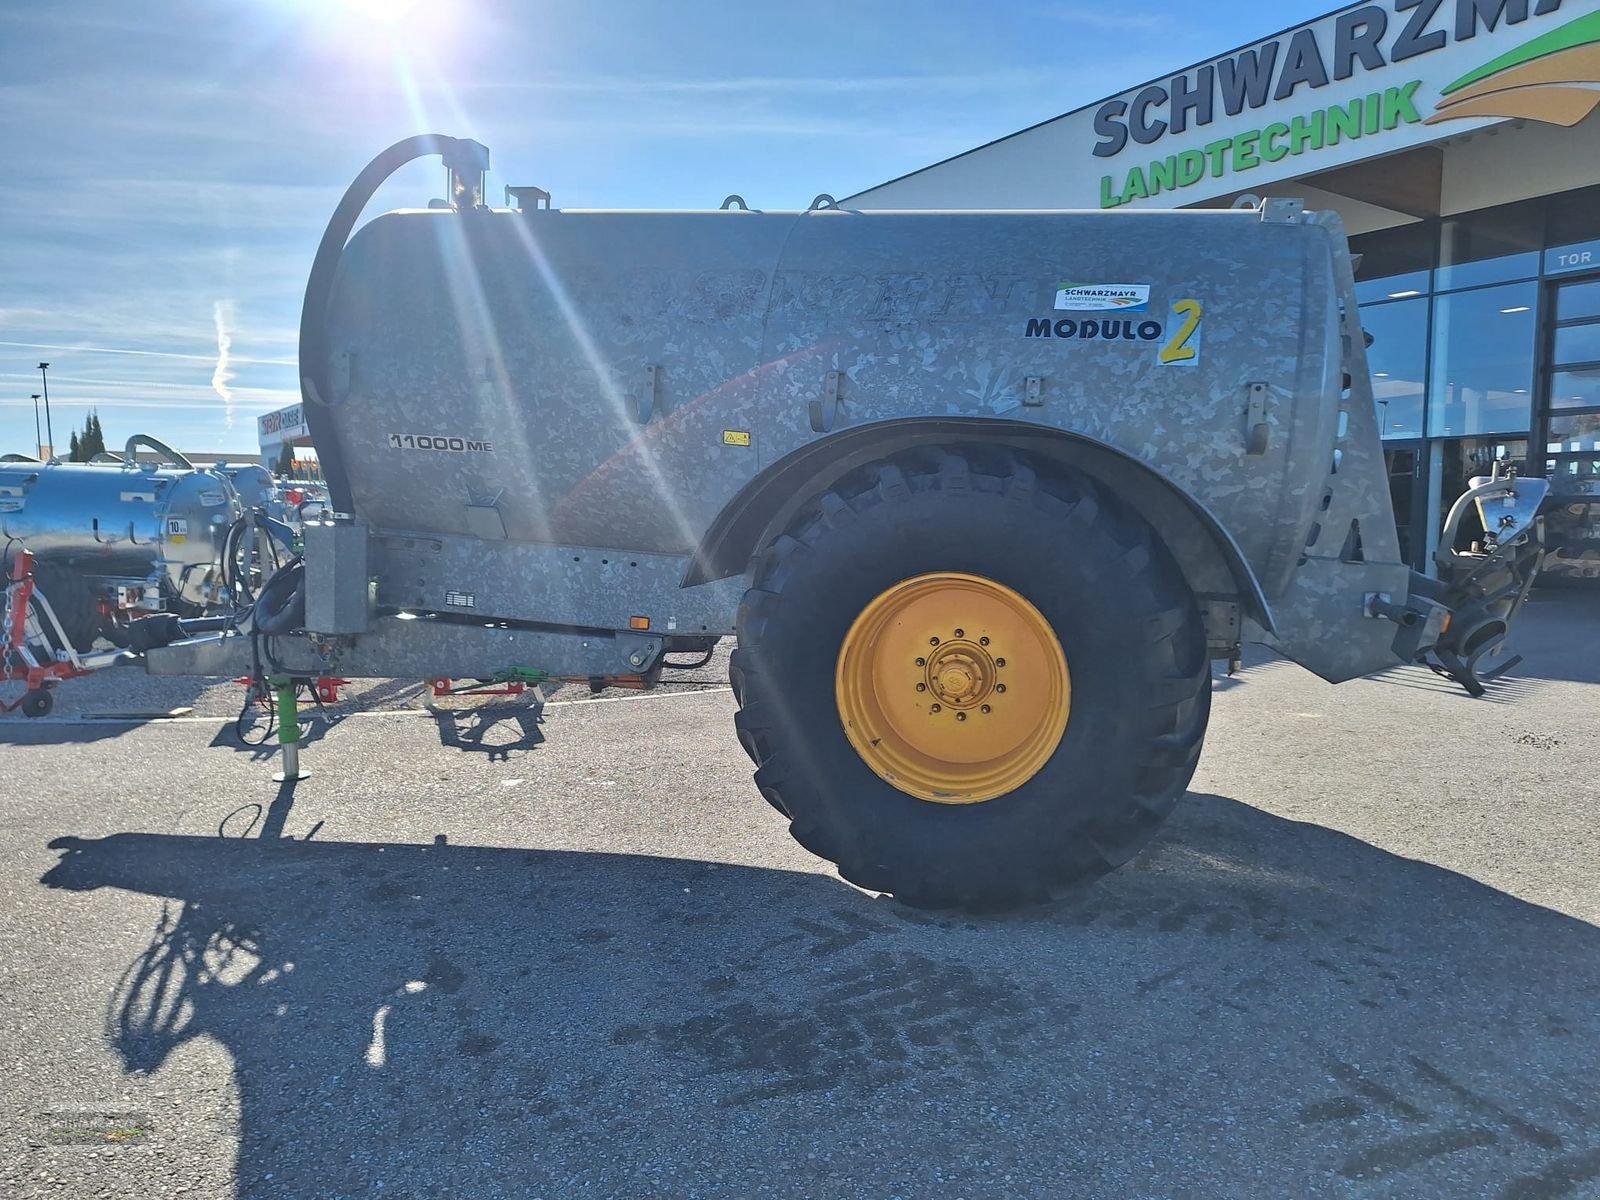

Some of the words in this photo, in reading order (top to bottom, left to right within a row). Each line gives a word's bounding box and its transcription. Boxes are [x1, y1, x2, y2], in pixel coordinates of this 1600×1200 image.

[1093, 0, 1562, 157] SCHWARZM
[1100, 79, 1423, 209] LANDTECHNIK
[1558, 251, 1592, 266] TOR
[1064, 289, 1137, 298] SCHWARZMAYR
[1025, 318, 1162, 341] MODULO
[1159, 298, 1202, 365] 2
[169, 521, 179, 533] 10
